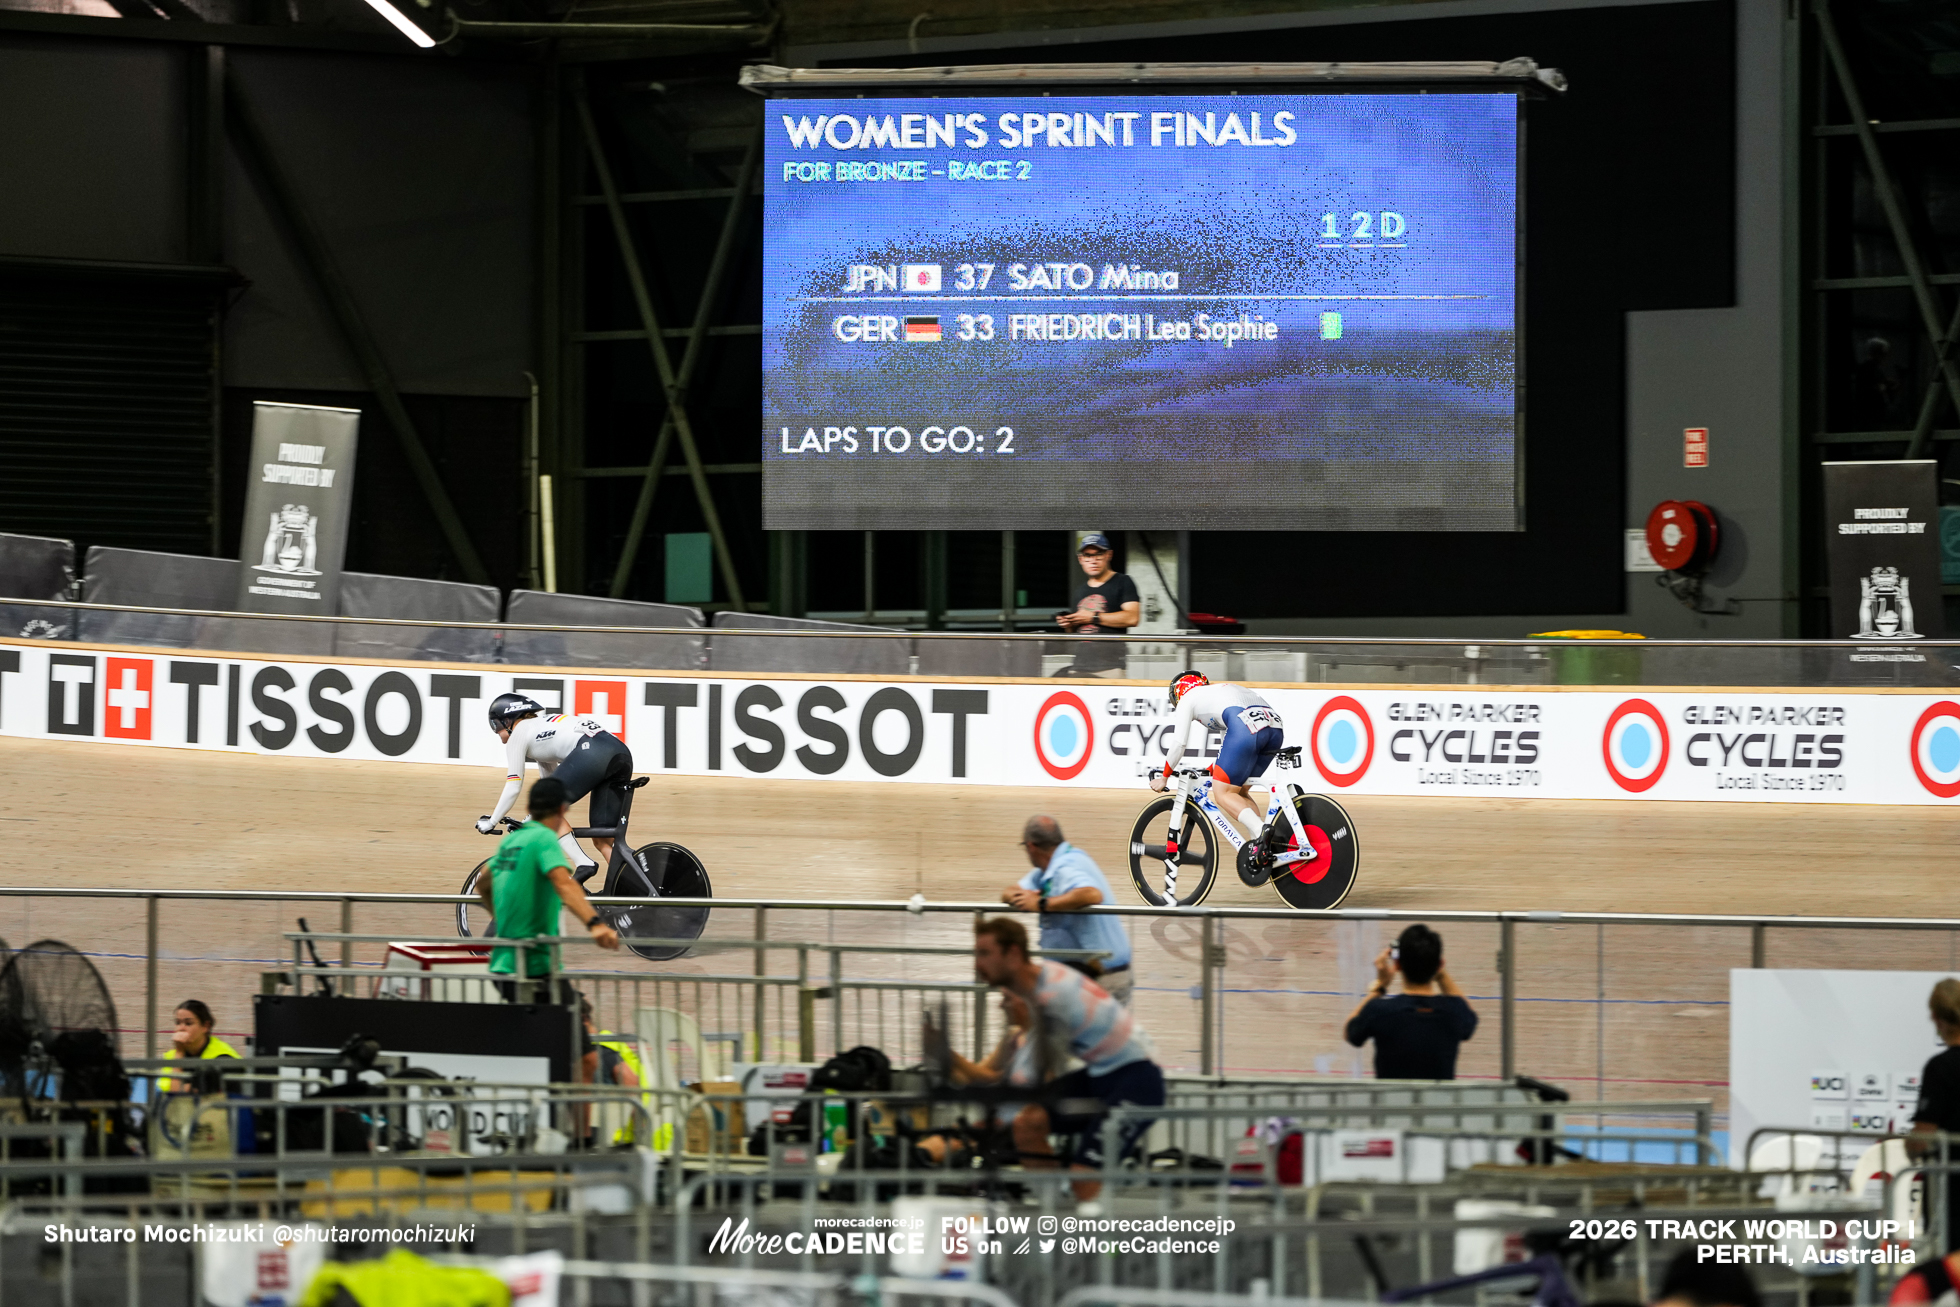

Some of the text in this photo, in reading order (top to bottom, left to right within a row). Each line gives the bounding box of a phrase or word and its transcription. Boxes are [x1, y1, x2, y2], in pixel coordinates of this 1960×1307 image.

[782, 111, 1298, 150] WOMEN'S SPRINT FINALS
[783, 161, 831, 182] FOR
[835, 160, 927, 182] BRONZE
[948, 160, 1012, 181] RACE
[1015, 160, 1032, 181] 2
[1321, 211, 1406, 238] 1 2 D
[844, 262, 1180, 293] JPN 37 SATO Mina
[833, 313, 1279, 348] GER 33 FRIEDRICH Lea Sophie
[781, 426, 1015, 454] LAPS TO GO: 2
[1854, 507, 1909, 519] PROUDLY
[1838, 523, 1907, 535] SUPPORTED
[169, 660, 481, 759] TISSOT
[504, 703, 533, 714] LAZER
[1106, 698, 1160, 717] GLEN
[1388, 703, 1541, 724] GLEN PARKER
[1683, 705, 1846, 726] GLEN PARKER
[536, 730, 556, 739] KTM
[581, 720, 602, 731] 33
[644, 682, 989, 778] TISSOT
[1390, 729, 1539, 765] CYCLES
[1686, 732, 1846, 769] CYCLES
[1418, 767, 1458, 785] Local
[1461, 768, 1501, 786] Since
[1716, 772, 1758, 790] Local
[1761, 774, 1804, 791] Since
